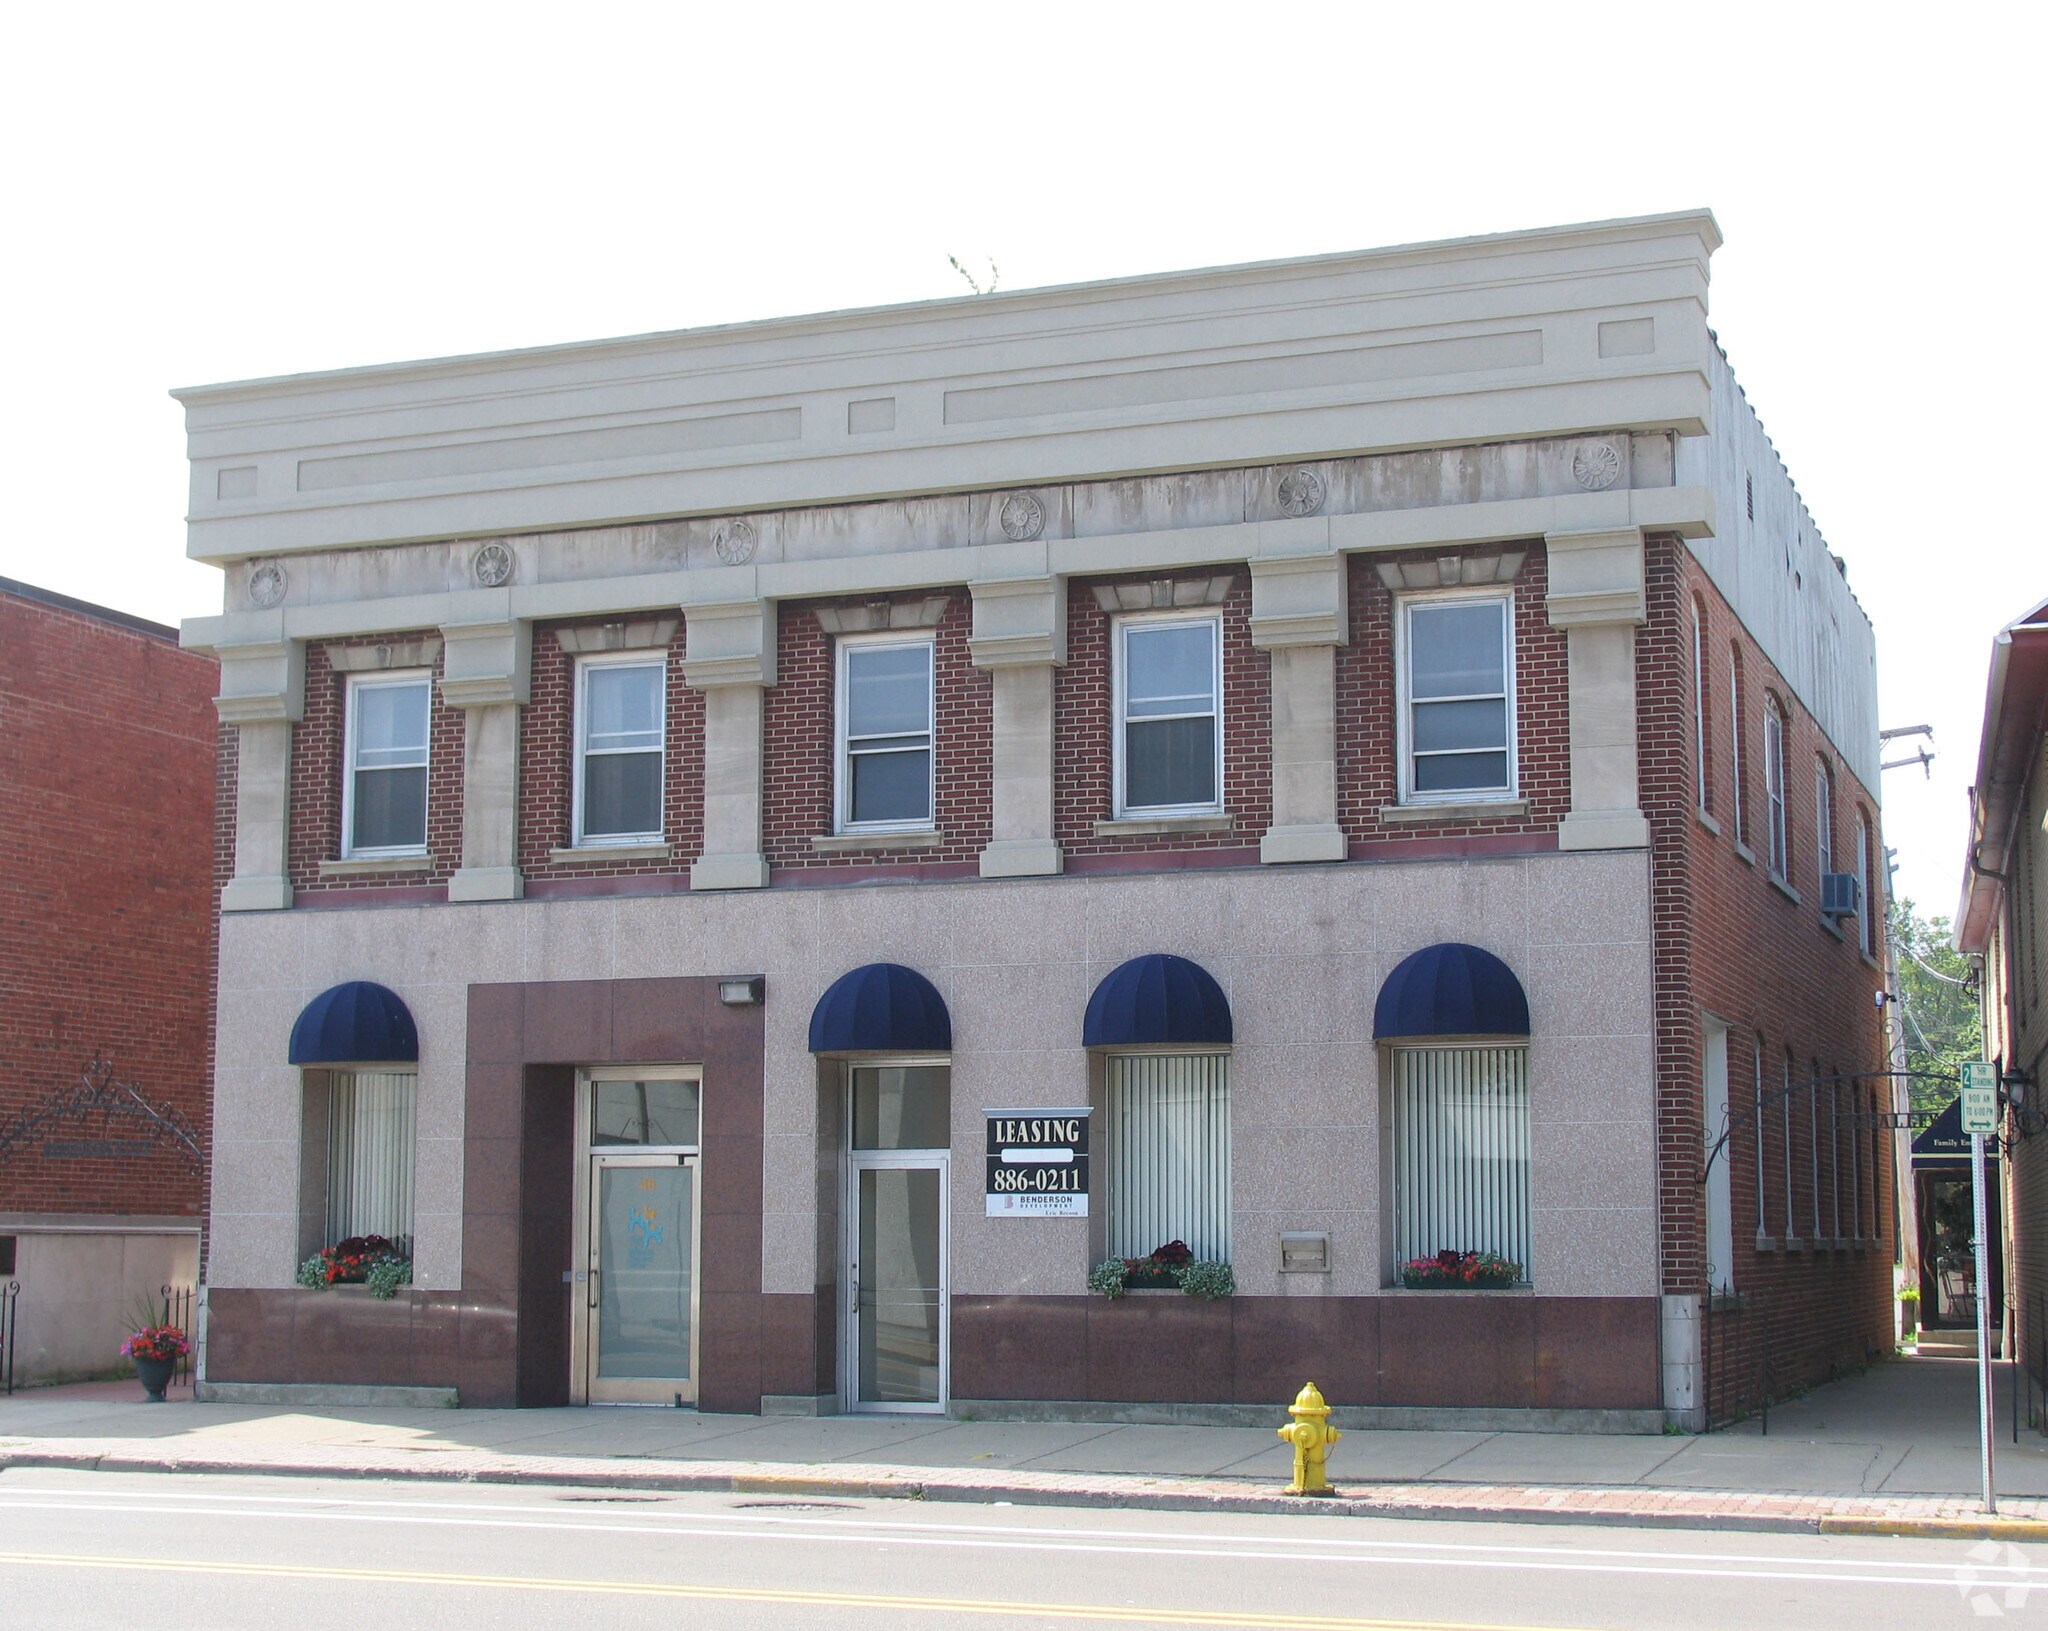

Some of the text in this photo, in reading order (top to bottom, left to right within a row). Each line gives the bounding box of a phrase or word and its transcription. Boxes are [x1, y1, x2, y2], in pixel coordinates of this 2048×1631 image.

[1963, 1067, 1970, 1085] 2
[1971, 1077, 1993, 1086] STANDING
[1983, 1094, 1990, 1103] AM
[1966, 1107, 1973, 1116] TO
[1986, 1107, 1993, 1116] PM
[995, 1119, 1080, 1143] LEASING
[1933, 1138, 1957, 1147] Family
[994, 1168, 1080, 1191] 886-0211
[1020, 1195, 1073, 1204] BENDERSON
